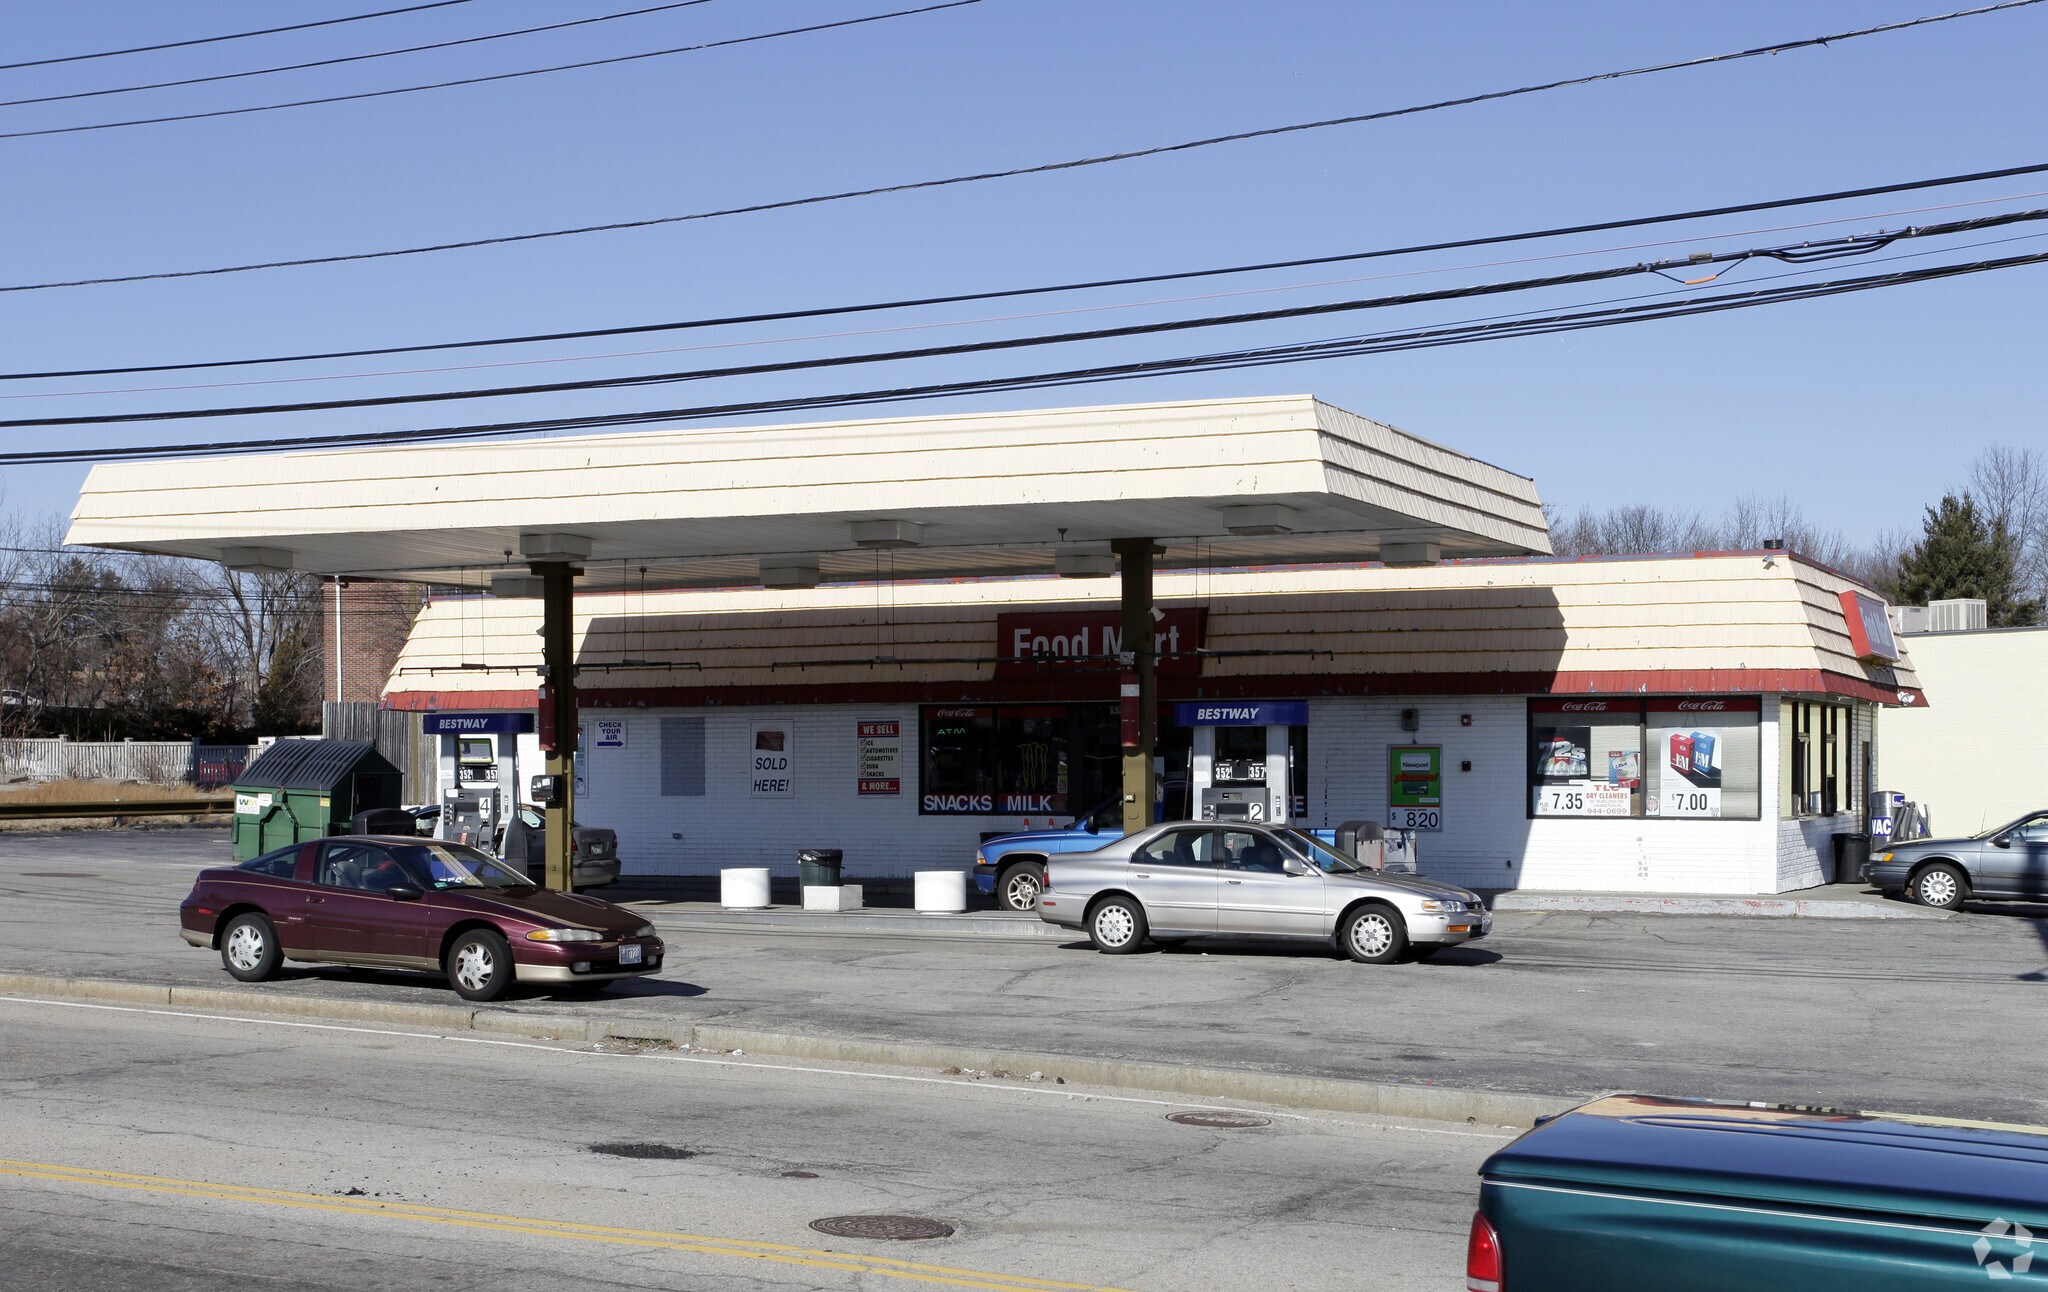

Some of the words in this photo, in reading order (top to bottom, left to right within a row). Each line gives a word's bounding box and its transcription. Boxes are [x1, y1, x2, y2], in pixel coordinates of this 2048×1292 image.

[1014, 627, 1088, 663] Food
[1103, 626, 1179, 661] Mrt
[1562, 702, 1607, 712] Coca-Cola
[1678, 701, 1725, 710] Coca-Cola
[937, 708, 975, 717] Coca-Cola
[1197, 708, 1259, 719] BESTWAY
[440, 719, 488, 729] BESTWAY
[863, 725, 874, 734] WE
[877, 725, 894, 734] SELL
[755, 758, 787, 770] SOLD
[753, 779, 789, 791] HERE!
[869, 782, 896, 790] MORE...
[480, 799, 489, 813] 4
[924, 795, 992, 811] SNACKS
[1007, 796, 1052, 811] MILK
[1553, 793, 1583, 809] 7.35
[1250, 804, 1262, 820] 2
[1392, 812, 1396, 820] $
